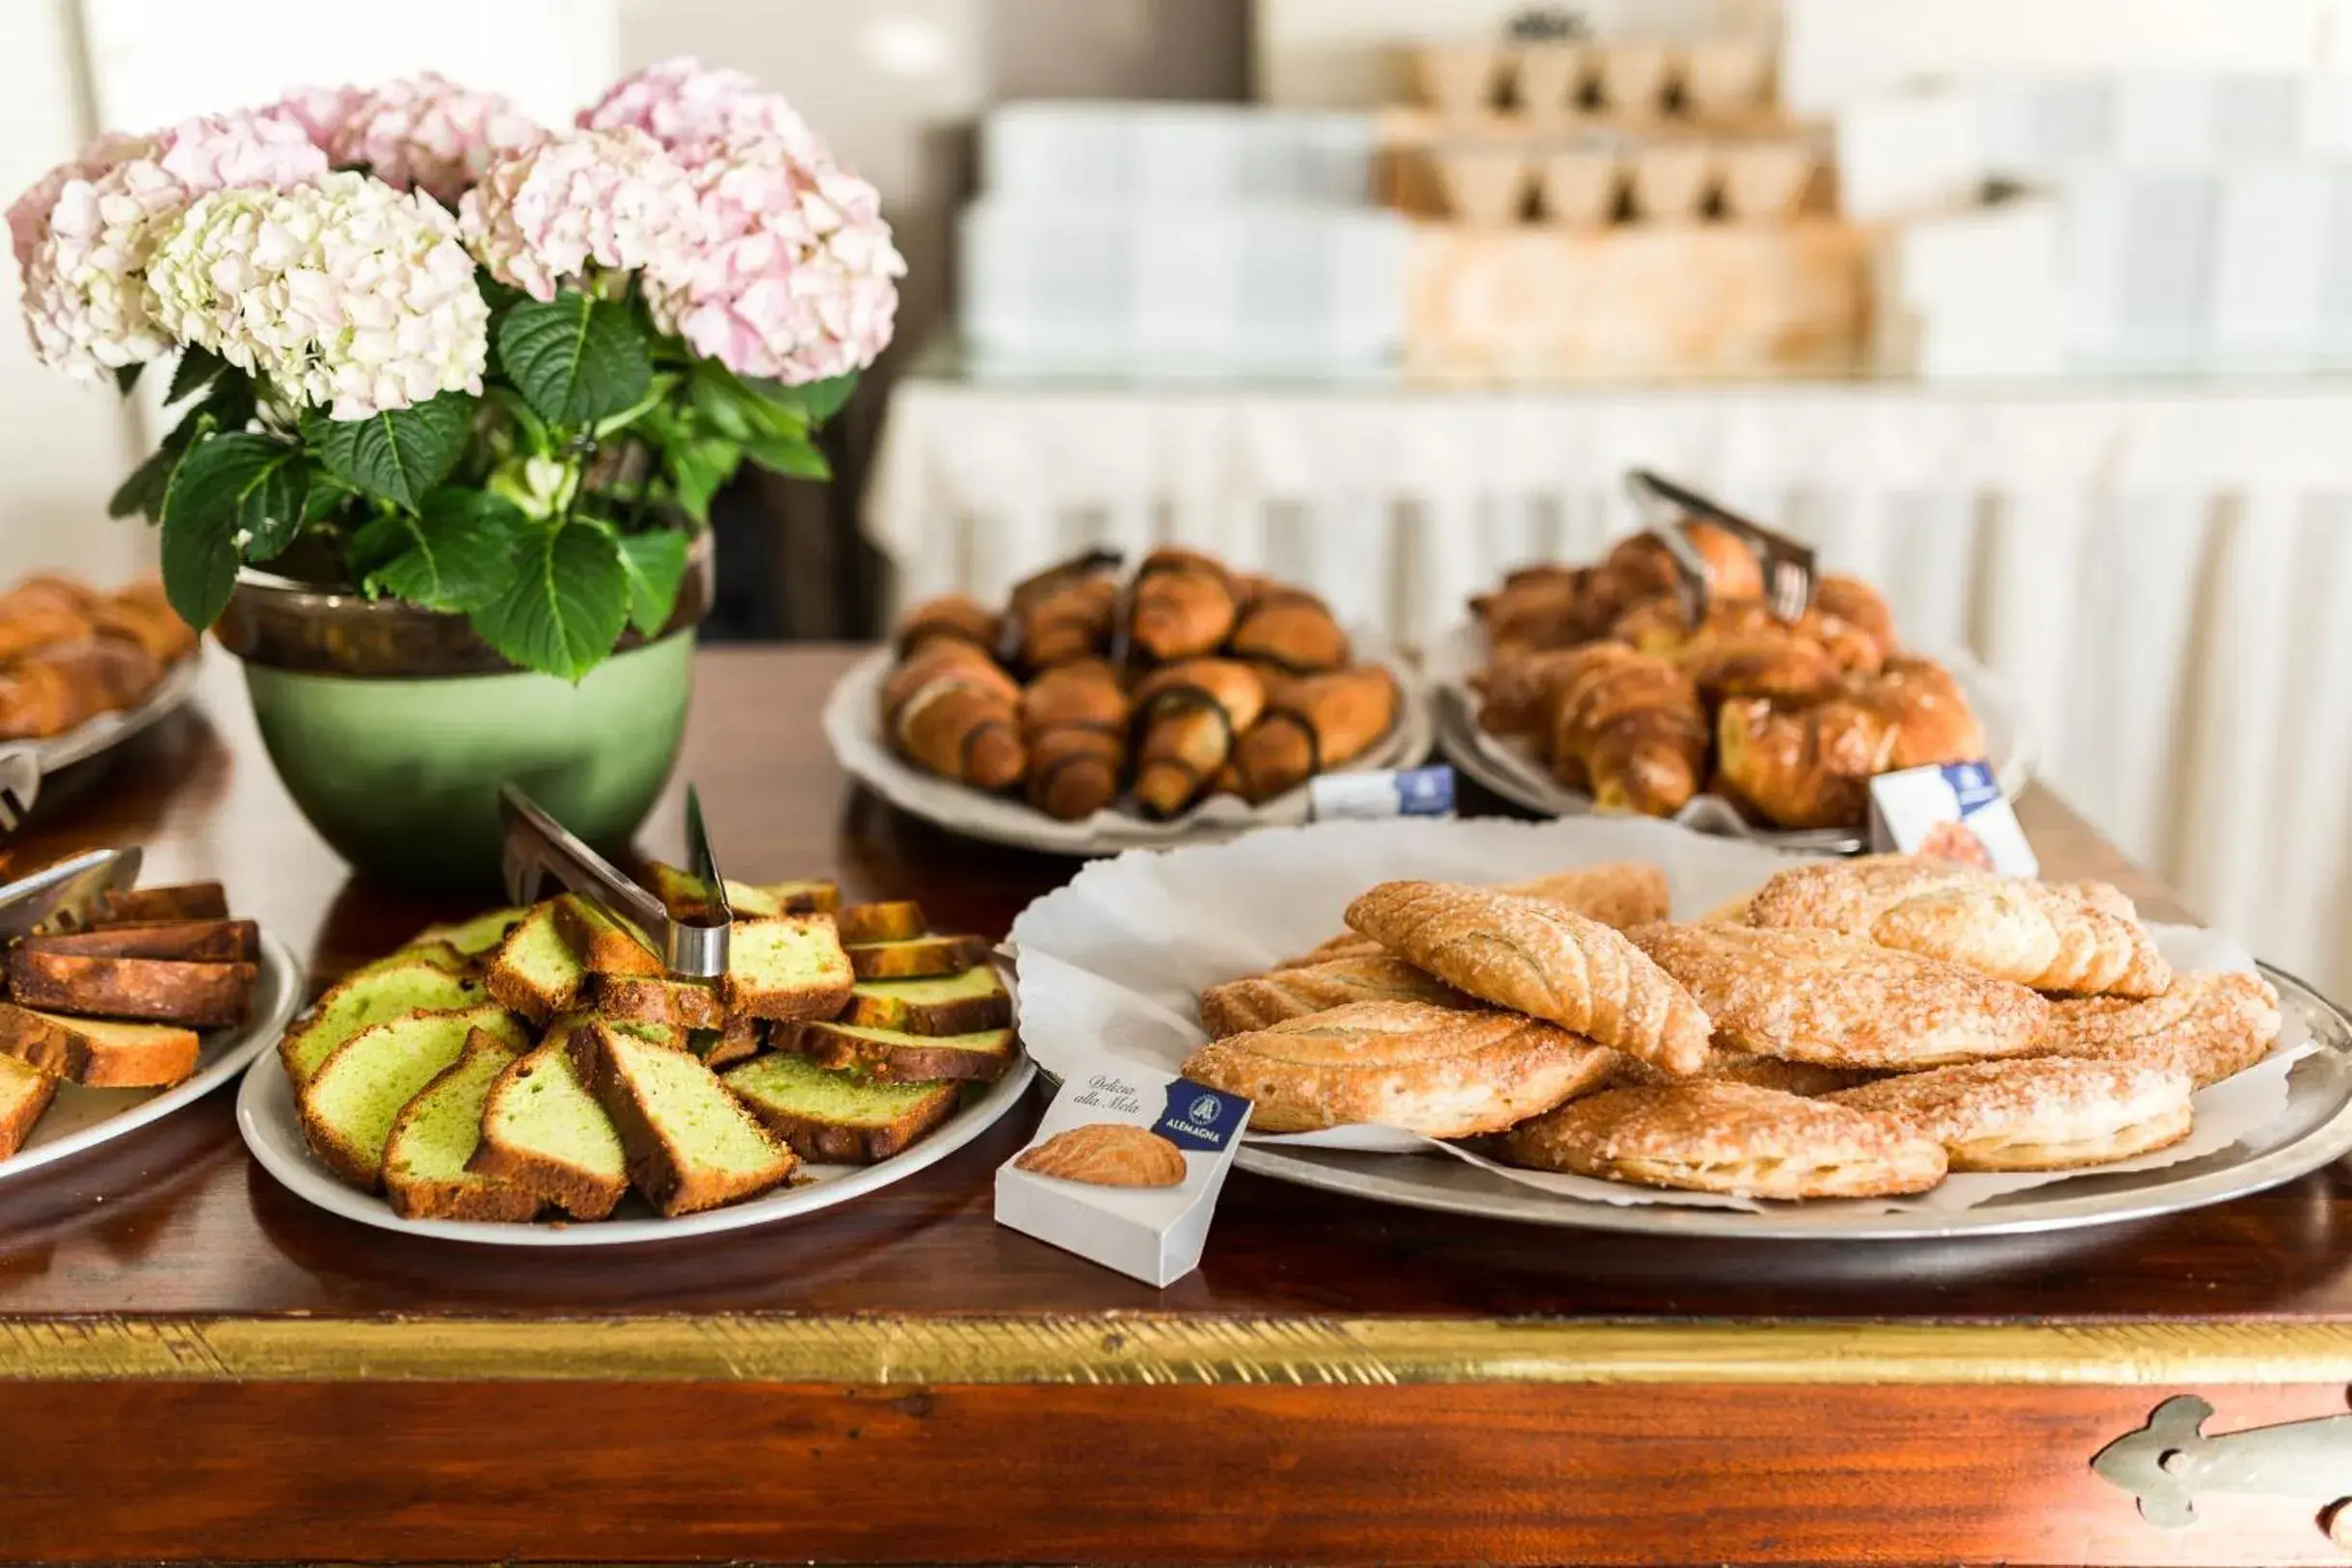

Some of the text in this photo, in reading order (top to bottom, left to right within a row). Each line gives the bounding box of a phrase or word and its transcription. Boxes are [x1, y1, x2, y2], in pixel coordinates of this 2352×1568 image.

[1089, 1075, 1135, 1095] Delizia
[1073, 1091, 1141, 1114] alla Mela
[1166, 1118, 1219, 1143] ALEMAGNA
